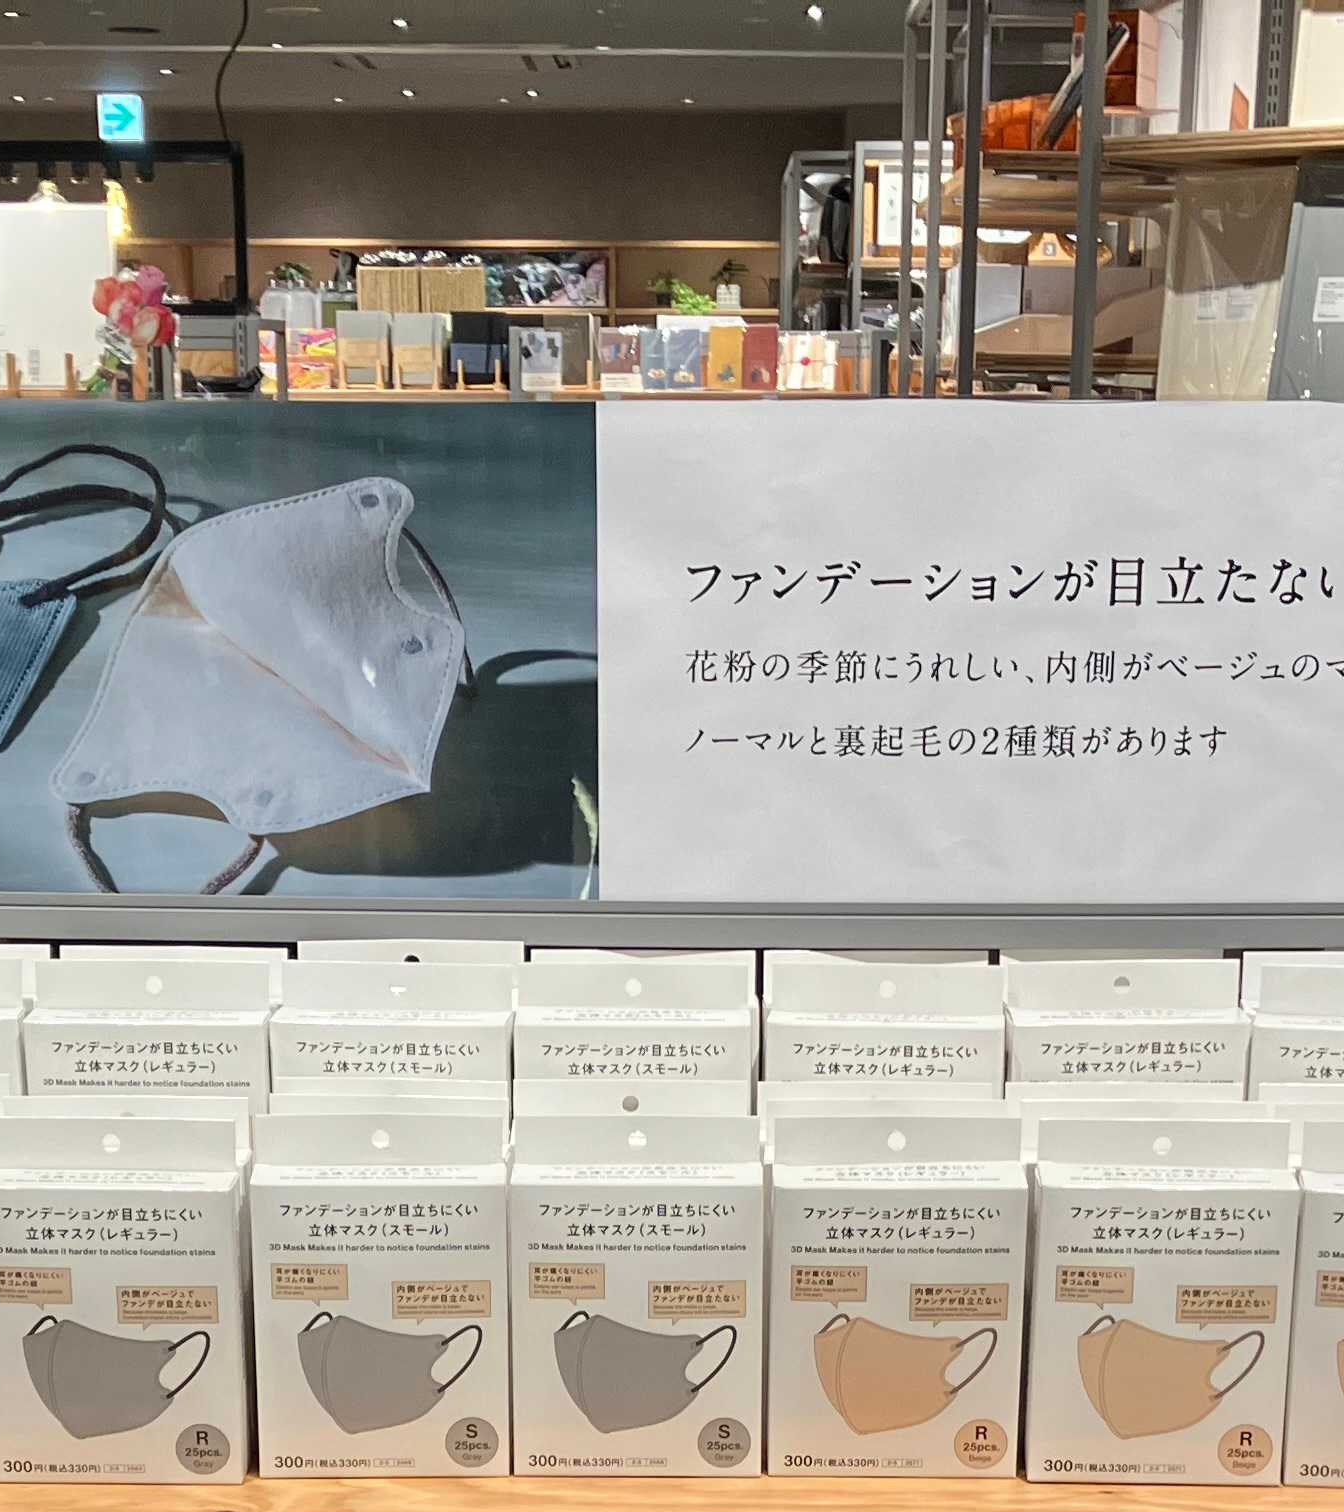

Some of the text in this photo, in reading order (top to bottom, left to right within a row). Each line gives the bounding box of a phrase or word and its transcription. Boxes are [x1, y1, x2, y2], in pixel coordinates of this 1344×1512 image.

[684, 722, 1229, 760] ノーマルと裏起毛の2種類があります
[51, 1041, 238, 1055] ファンデーションが目立ちにくい
[296, 1042, 480, 1057] ファンデーションが目立ちにくい
[541, 1043, 726, 1058] ファンデーションが目立ちにくい
[792, 1043, 979, 1059] ファンデーションが目立ちにくい
[1041, 1040, 1226, 1056] ファンデーションが目立ちにくい
[74, 1060, 216, 1074] 立体マスク(レギュラー)
[323, 1060, 453, 1075] 立体マスク(スモール)
[568, 1061, 698, 1076] 立体マスク(スモール)
[814, 1062, 955, 1078] 立体マスク(レギュラー)
[1061, 1059, 1203, 1075] 立体マスク(レギュラー)
[0, 1207, 202, 1222] ファンデーションが目立ちにくい
[280, 1203, 478, 1217] ファンデーションが目立ちにくい
[539, 1203, 736, 1217] ファンデーションが目立ちにくい
[803, 1207, 1000, 1221] ファンデーションが目立ちにくい
[1070, 1206, 1271, 1221] ファンデーションが目立ちにくい
[26, 1227, 178, 1241] 立体マスク(レギュラー)
[309, 1224, 449, 1237] 立体マスク(スモール)
[567, 1224, 706, 1237] 立体マスク(スモール)
[825, 1226, 975, 1240] 立体マスク(レギュラー)
[1092, 1227, 1245, 1241] 立体マスク(レギュラー)
[30, 1247, 59, 1255] Makes
[68, 1248, 97, 1256] harder
[139, 1248, 187, 1256] foundation
[196, 1430, 209, 1445] R
[465, 1423, 478, 1439] S
[718, 1424, 731, 1439] S
[975, 1426, 988, 1440] R
[1239, 1431, 1252, 1446] R
